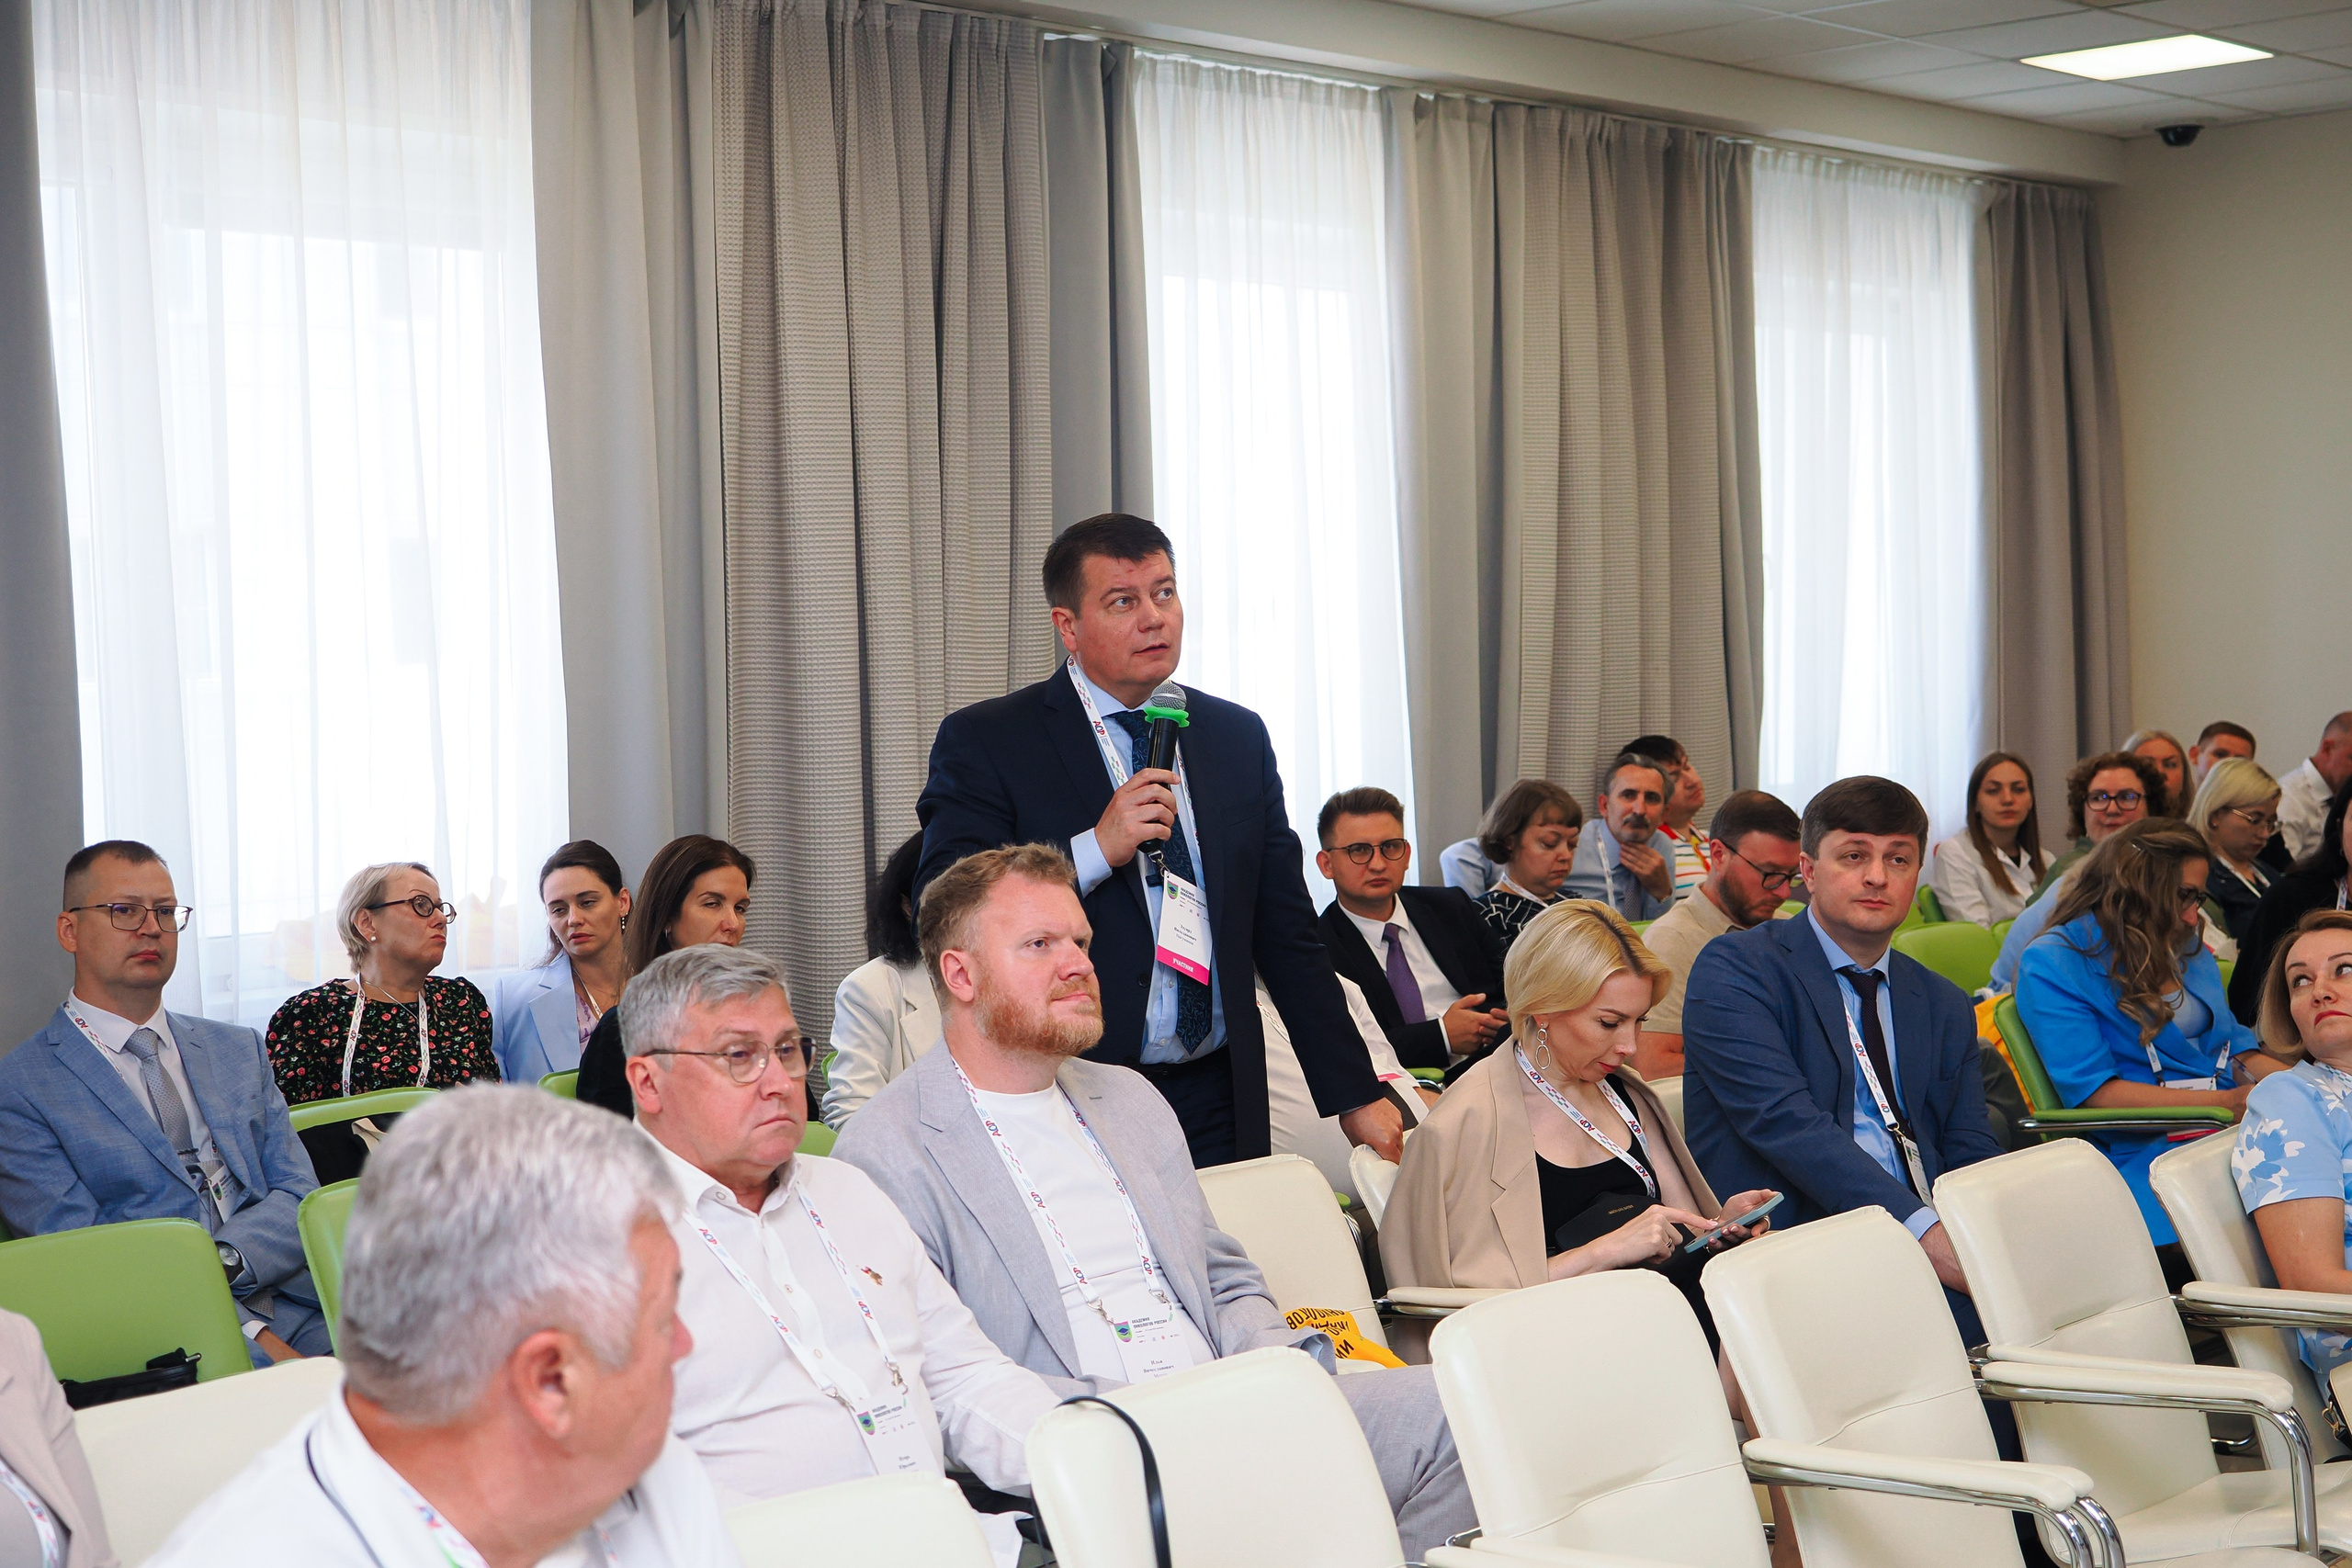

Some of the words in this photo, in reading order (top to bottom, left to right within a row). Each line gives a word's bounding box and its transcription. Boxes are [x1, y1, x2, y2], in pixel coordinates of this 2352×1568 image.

[1092, 720, 1105, 736] АОР
[1854, 1043, 1867, 1057] АОР
[1529, 1070, 1545, 1085] АОР
[1073, 1109, 1087, 1127] АОР
[1579, 1119, 1596, 1133] АОР
[985, 1119, 1002, 1137] АОР
[1628, 1120, 1642, 1135] АОР
[1634, 1164, 1649, 1178] АОР
[1113, 1177, 1125, 1196] АОР
[1030, 1191, 1046, 1209] АОР
[809, 1209, 825, 1229] АОР
[698, 1228, 718, 1246] АОР
[1141, 1255, 1153, 1275] АОР
[1073, 1267, 1089, 1285] АОР
[857, 1301, 874, 1320] АОР
[770, 1314, 788, 1333] АОР
